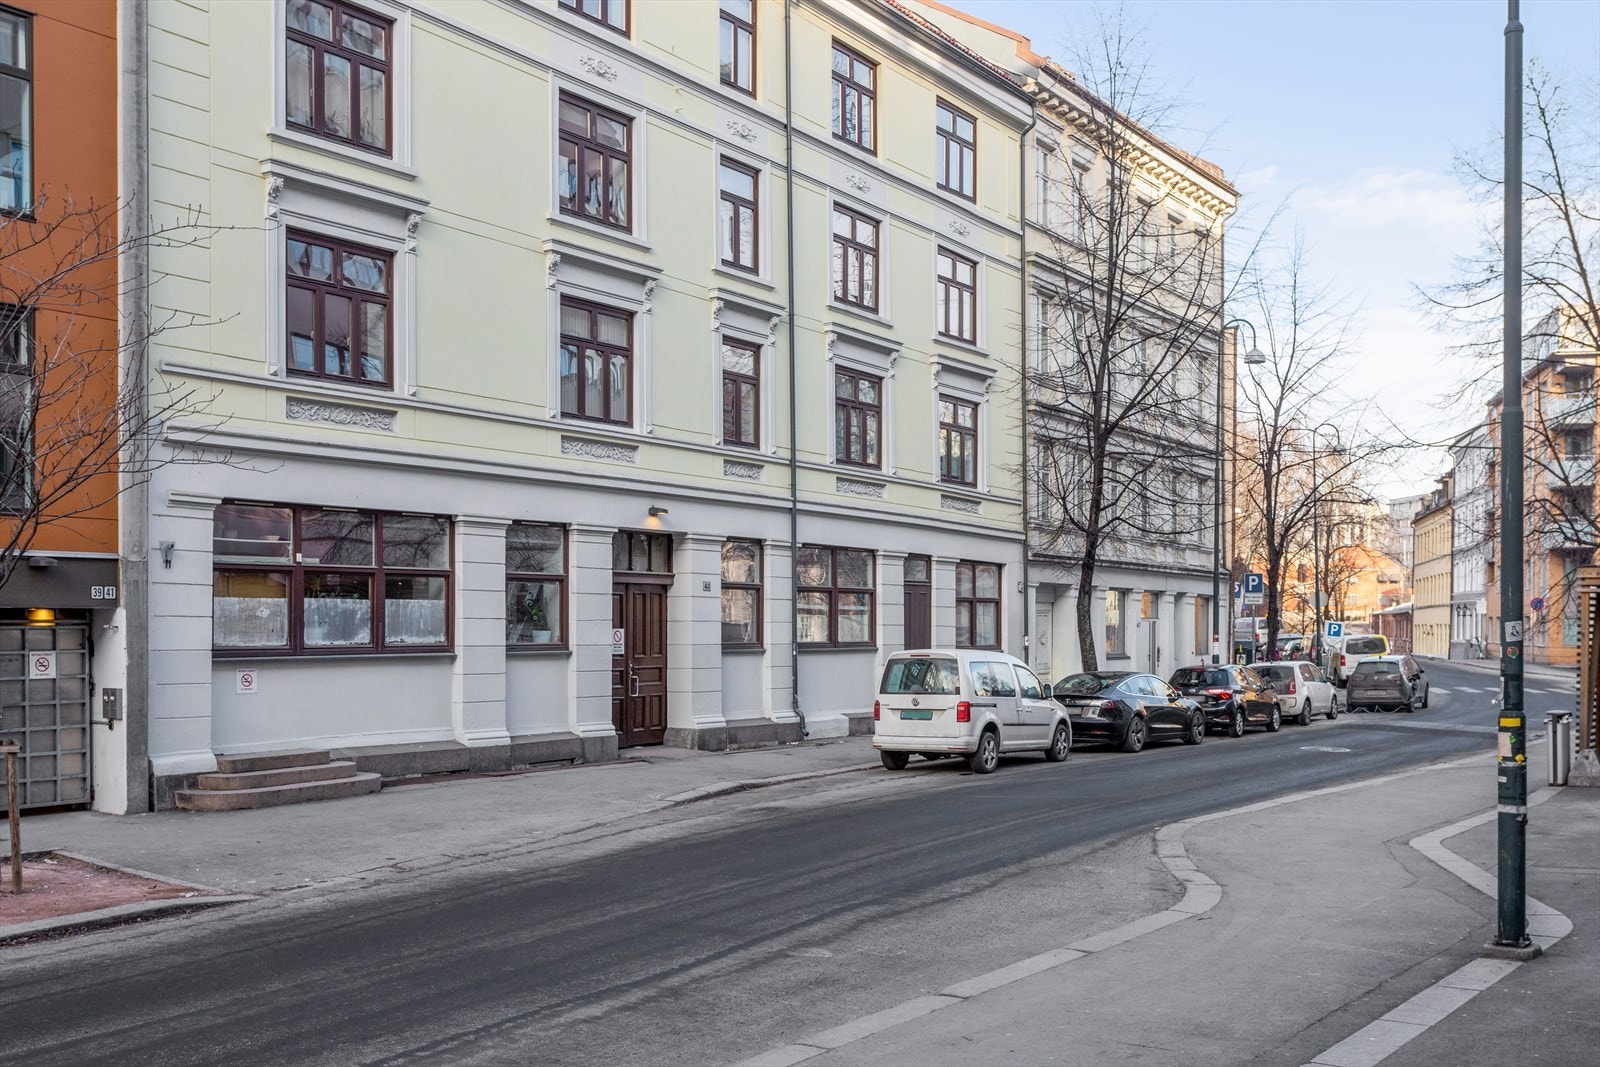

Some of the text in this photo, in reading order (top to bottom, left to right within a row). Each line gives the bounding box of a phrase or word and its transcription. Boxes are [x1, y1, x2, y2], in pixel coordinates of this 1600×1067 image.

[1249, 575, 1259, 591] P
[92, 587, 102, 598] 39
[105, 587, 114, 598] 41
[1330, 625, 1339, 635] P
